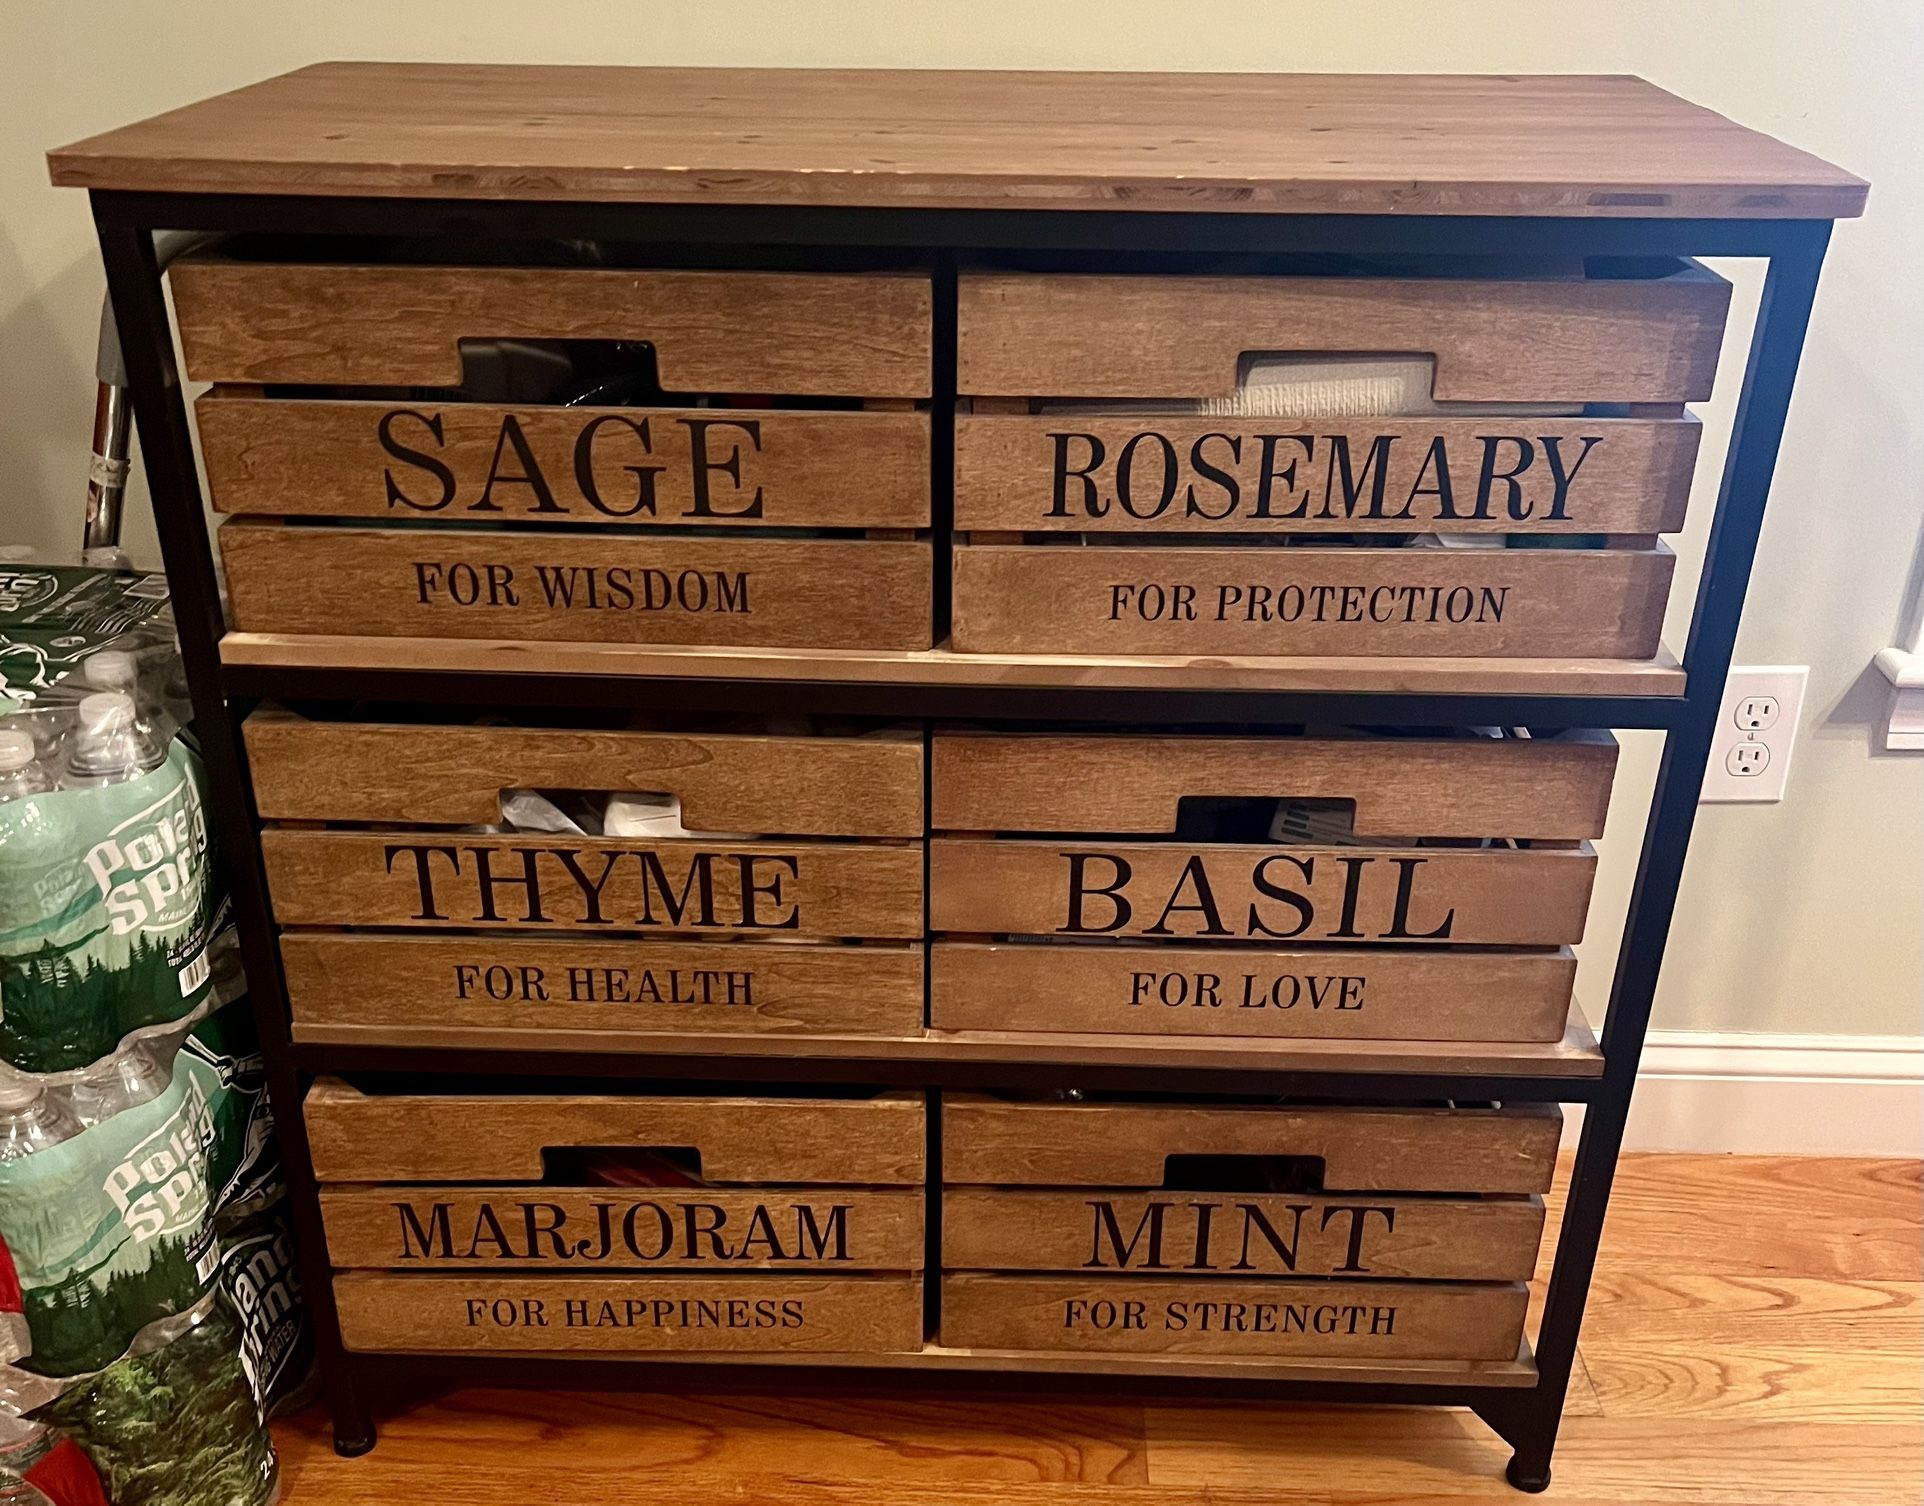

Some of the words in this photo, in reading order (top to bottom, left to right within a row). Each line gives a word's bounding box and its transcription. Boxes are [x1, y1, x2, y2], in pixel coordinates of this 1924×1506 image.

[379, 410, 762, 517] SAGE
[1043, 432, 1603, 520] ROSEMARY
[412, 563, 519, 606] FOR
[536, 566, 751, 612] WISDOM
[1108, 584, 1197, 621] FOR
[1214, 585, 1510, 623] PROTECTION
[385, 846, 799, 929] THYME
[1057, 853, 1454, 938] BASIL
[453, 966, 549, 1001] FOR
[567, 968, 755, 1006] HEALTH
[1128, 973, 1222, 1007] FOR
[1239, 975, 1365, 1010] LOVE
[394, 1202, 854, 1260] MARJORAM
[1083, 1202, 1395, 1272] MINT
[467, 1299, 548, 1327] FOR
[566, 1300, 803, 1328] HAPPINESS
[1064, 1300, 1147, 1329] FOR
[1166, 1302, 1397, 1335] STRENGTH
